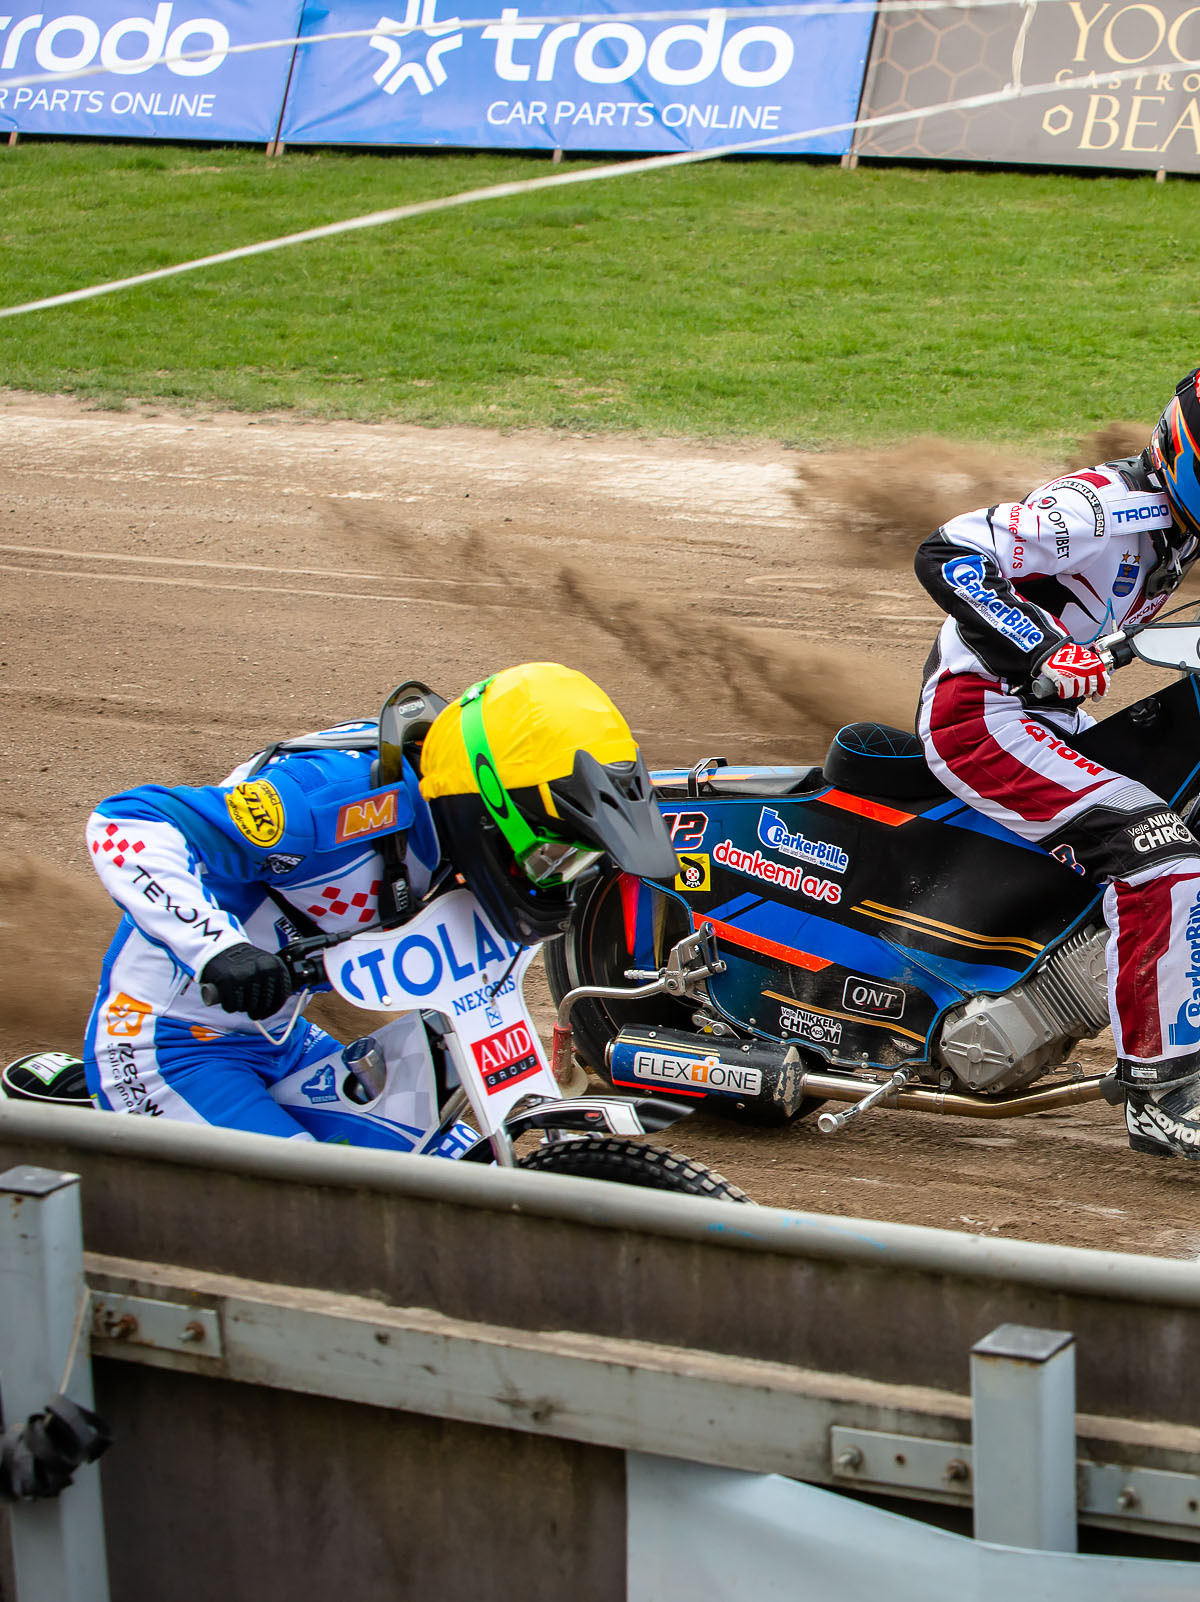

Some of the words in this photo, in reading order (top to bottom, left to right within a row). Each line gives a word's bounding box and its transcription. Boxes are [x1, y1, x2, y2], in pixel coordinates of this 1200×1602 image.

[0, 2, 230, 77] rodo
[480, 8, 795, 88] trodo
[13, 87, 105, 114] PARTS
[110, 91, 217, 118] ONLINE
[486, 100, 548, 126] CAR
[554, 101, 655, 128] PARTS
[660, 103, 783, 130] ONLINE
[1112, 504, 1169, 524] TRODO
[1048, 511, 1070, 560] OPTIBET
[956, 569, 1042, 645] BarkerBille
[343, 795, 394, 837] BM
[1127, 823, 1151, 837] Vejle
[773, 827, 848, 867] BarkerBille
[1133, 821, 1198, 853] CHRO
[715, 841, 801, 889] dankemi
[803, 878, 840, 902] a/s
[132, 864, 225, 943] TEXOM
[851, 986, 898, 1008] QNT
[780, 1016, 841, 1044] CHROM
[797, 1009, 835, 1029] NIKKEL
[835, 1022, 842, 1031] &
[480, 1026, 533, 1073] AMD
[487, 1056, 538, 1087] GROUP
